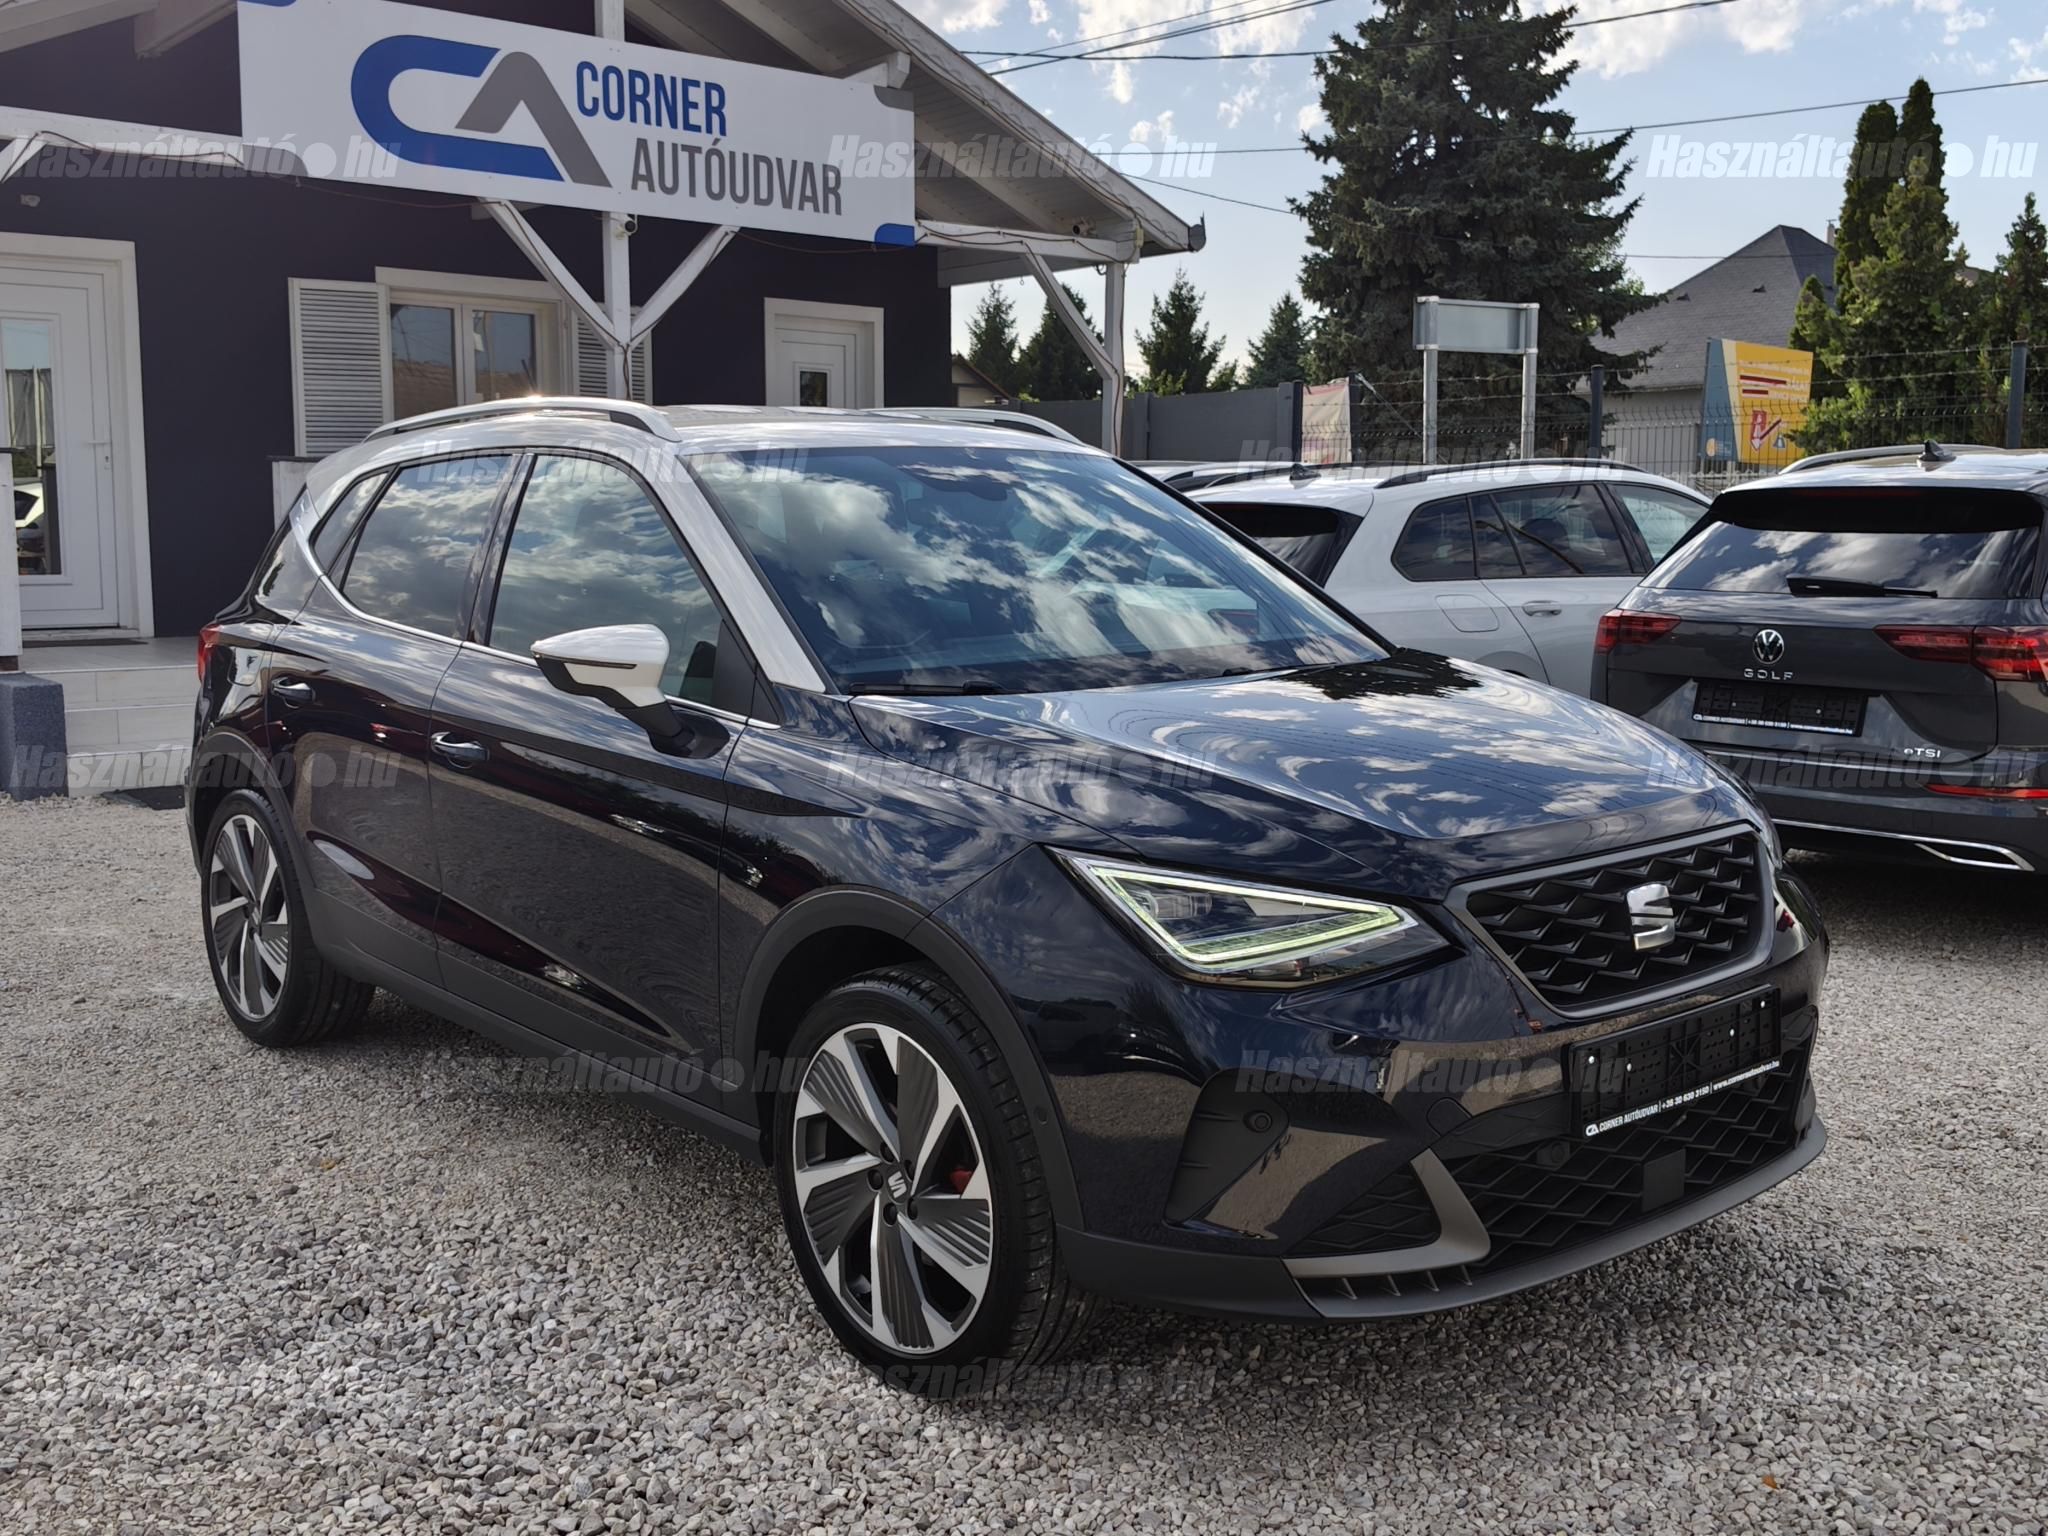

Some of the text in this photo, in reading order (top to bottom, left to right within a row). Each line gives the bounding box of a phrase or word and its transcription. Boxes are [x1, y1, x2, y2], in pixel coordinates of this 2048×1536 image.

[576, 61, 727, 136] CORNER
[631, 138, 843, 215] AUTÓUDVAR
[1743, 668, 1793, 680] GOLF
[1600, 1116, 1623, 1132] CORNER
